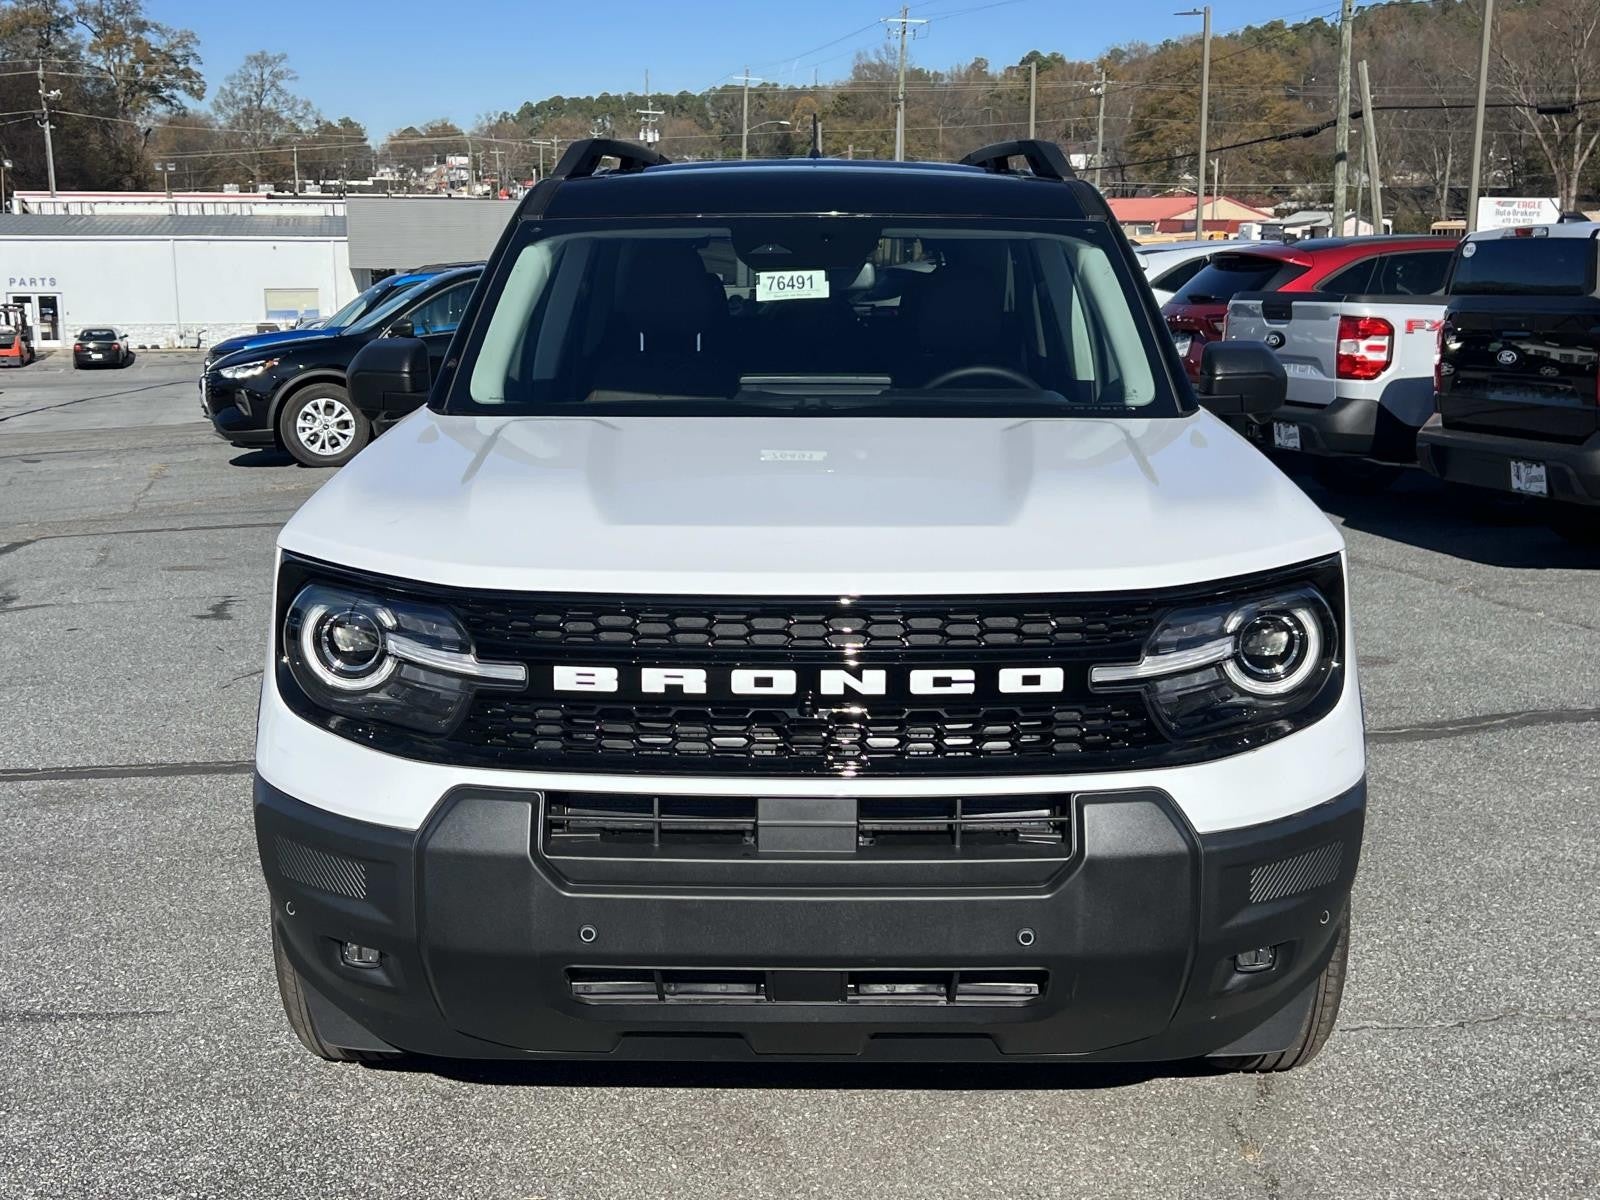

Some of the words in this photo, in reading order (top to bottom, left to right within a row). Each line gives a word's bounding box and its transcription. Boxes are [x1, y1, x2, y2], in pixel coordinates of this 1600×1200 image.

[1517, 201, 1543, 209] EAGLE
[1495, 208, 1511, 217] Auto
[9, 277, 57, 287] PARTS
[767, 274, 814, 291] 76491
[553, 665, 1064, 696] BRONCO
